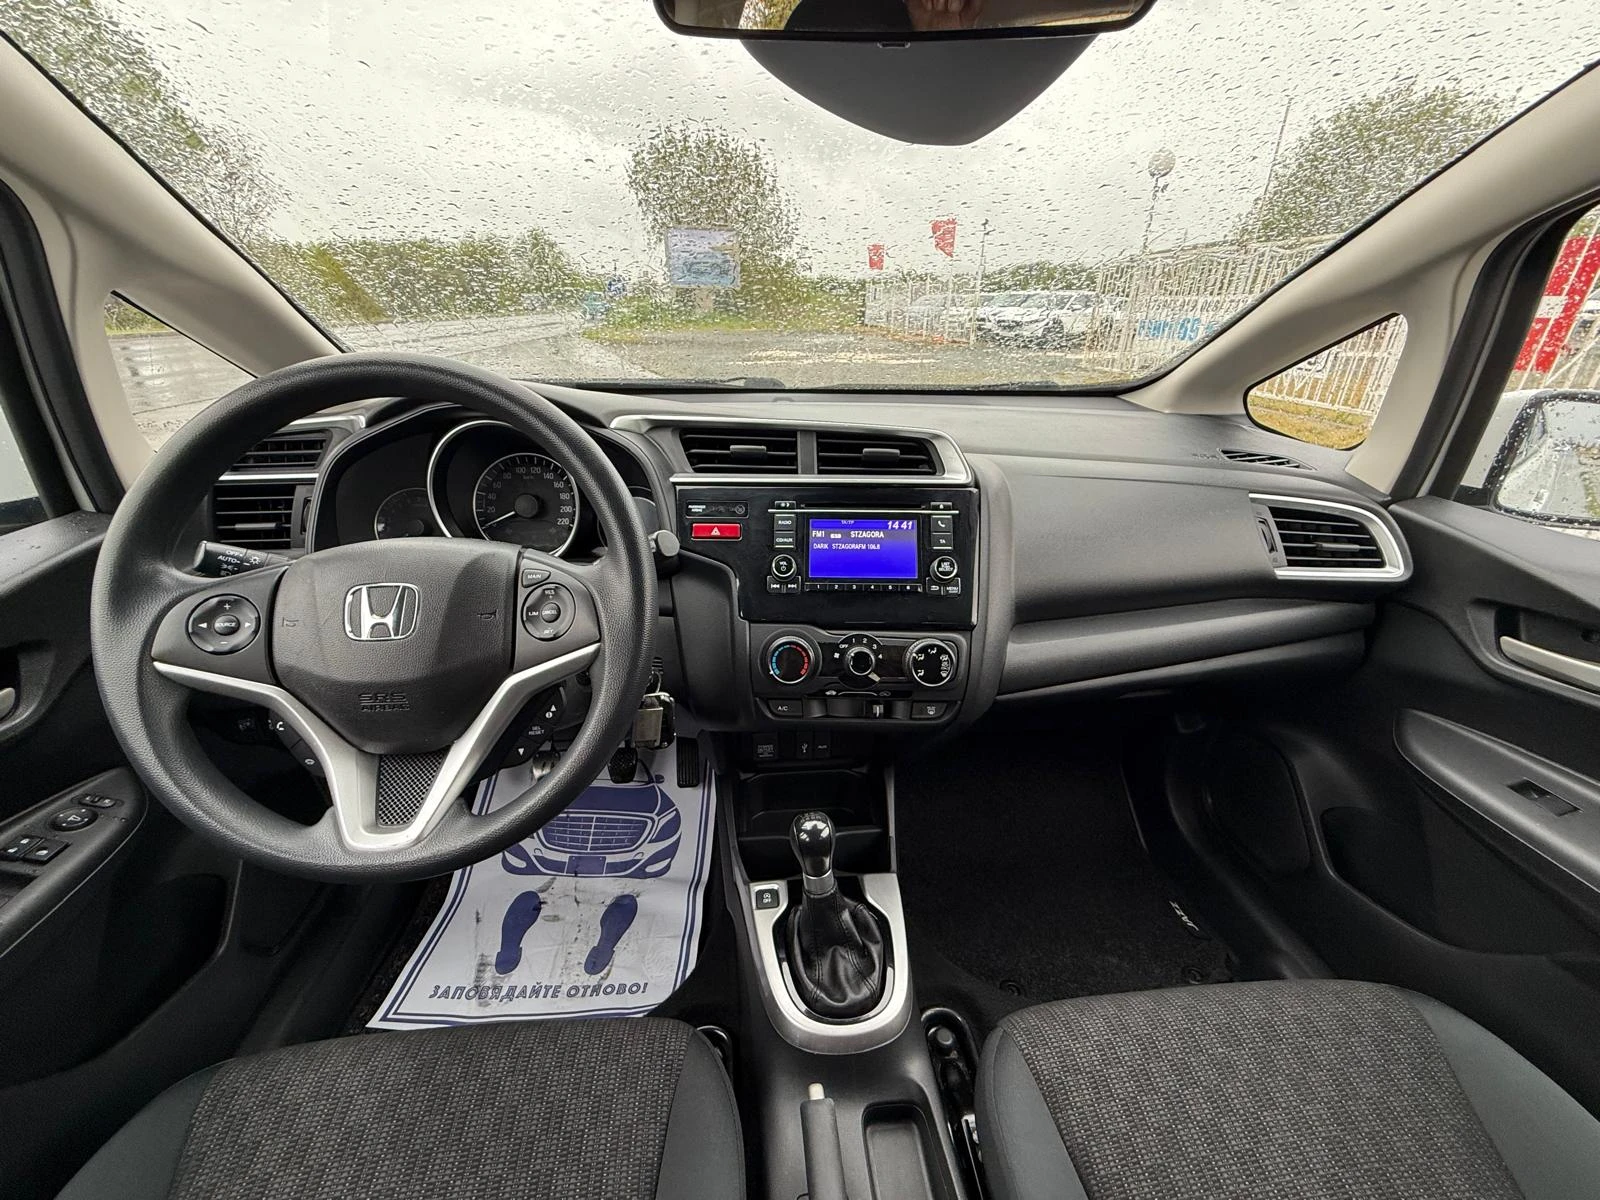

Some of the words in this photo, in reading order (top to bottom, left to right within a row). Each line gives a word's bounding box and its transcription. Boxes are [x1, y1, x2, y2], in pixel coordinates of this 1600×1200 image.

[218, 555, 237, 563] AUTO
[429, 982, 562, 1001] ЗАПОВЯДАЙТЕ
[566, 982, 648, 998] ОТНОВО!
